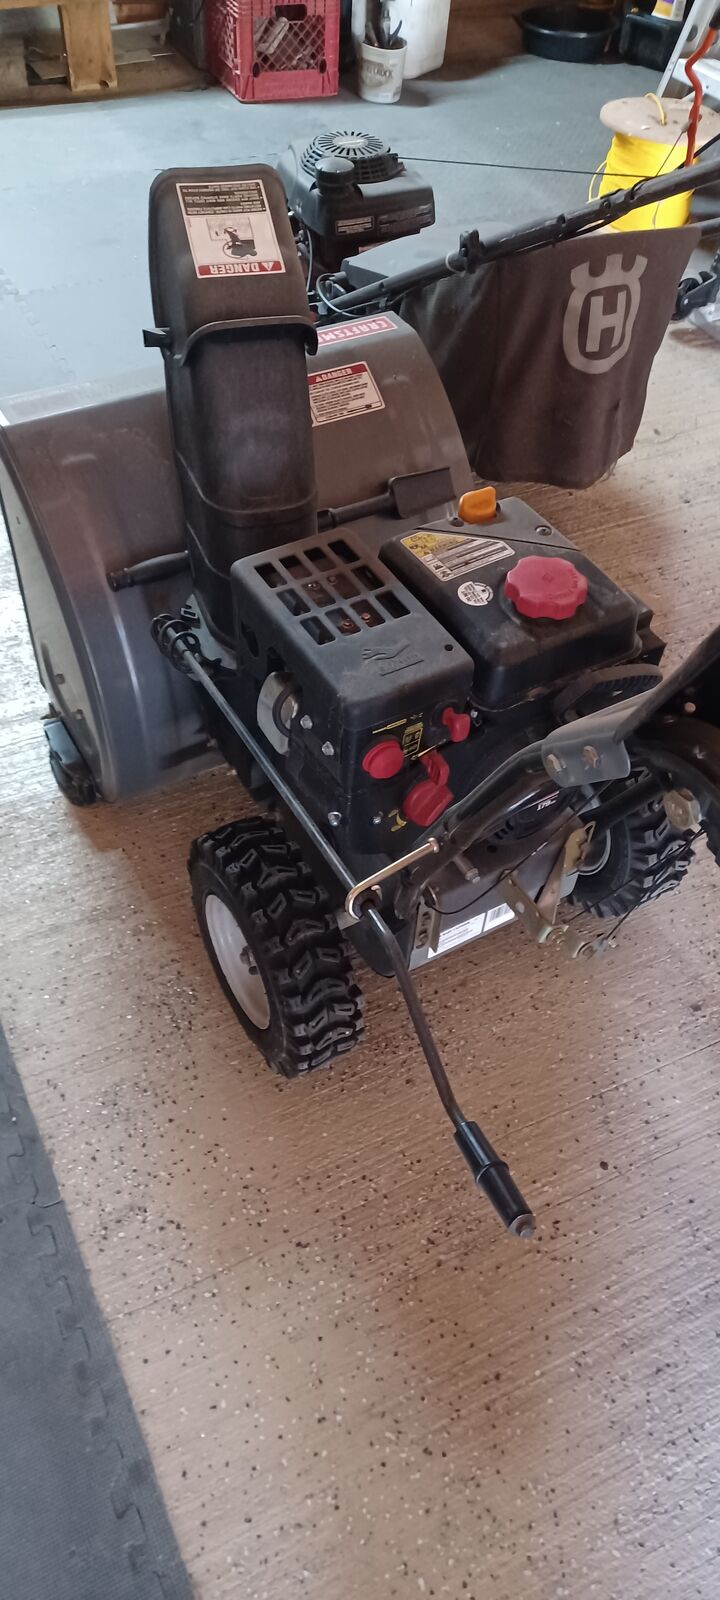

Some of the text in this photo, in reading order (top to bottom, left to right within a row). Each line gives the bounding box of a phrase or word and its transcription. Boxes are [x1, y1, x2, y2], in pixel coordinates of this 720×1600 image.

[209, 262, 260, 274] DANGER
[585, 290, 627, 353] H
[318, 319, 388, 343] CRAFTSM
[321, 368, 353, 381] DANGER
